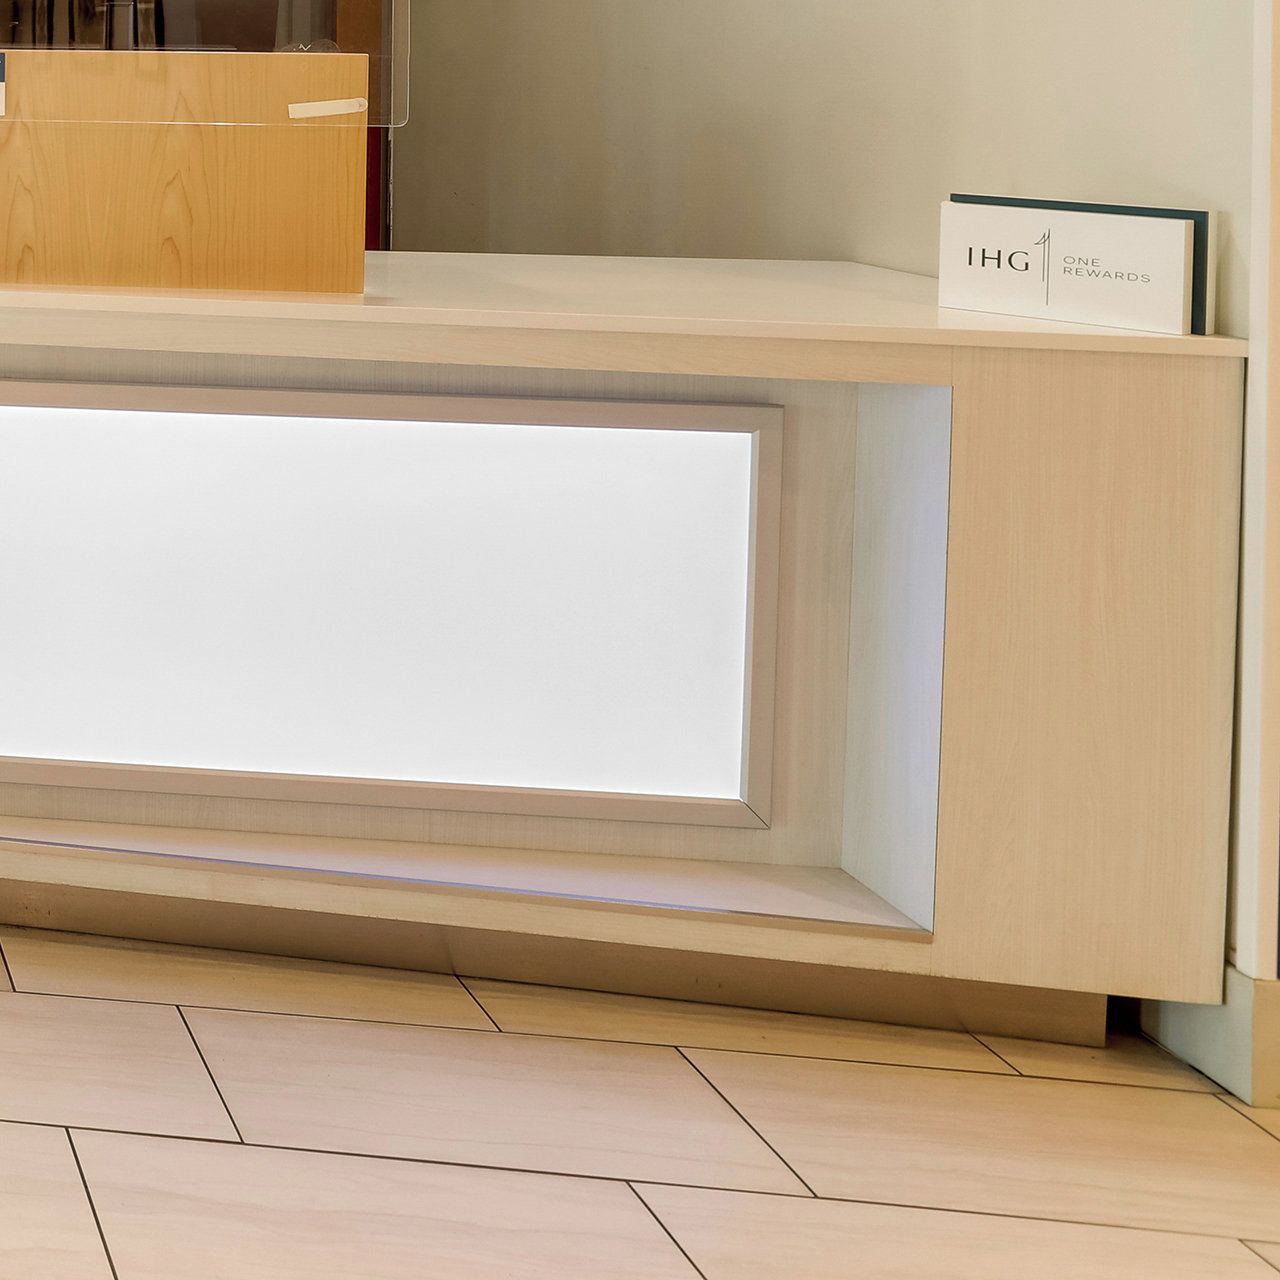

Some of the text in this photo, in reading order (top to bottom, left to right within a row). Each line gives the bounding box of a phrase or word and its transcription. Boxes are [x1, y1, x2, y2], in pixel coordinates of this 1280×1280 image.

[968, 247, 1029, 272] IHG
[1063, 255, 1101, 268] ONE
[1063, 266, 1151, 283] REWARDS
